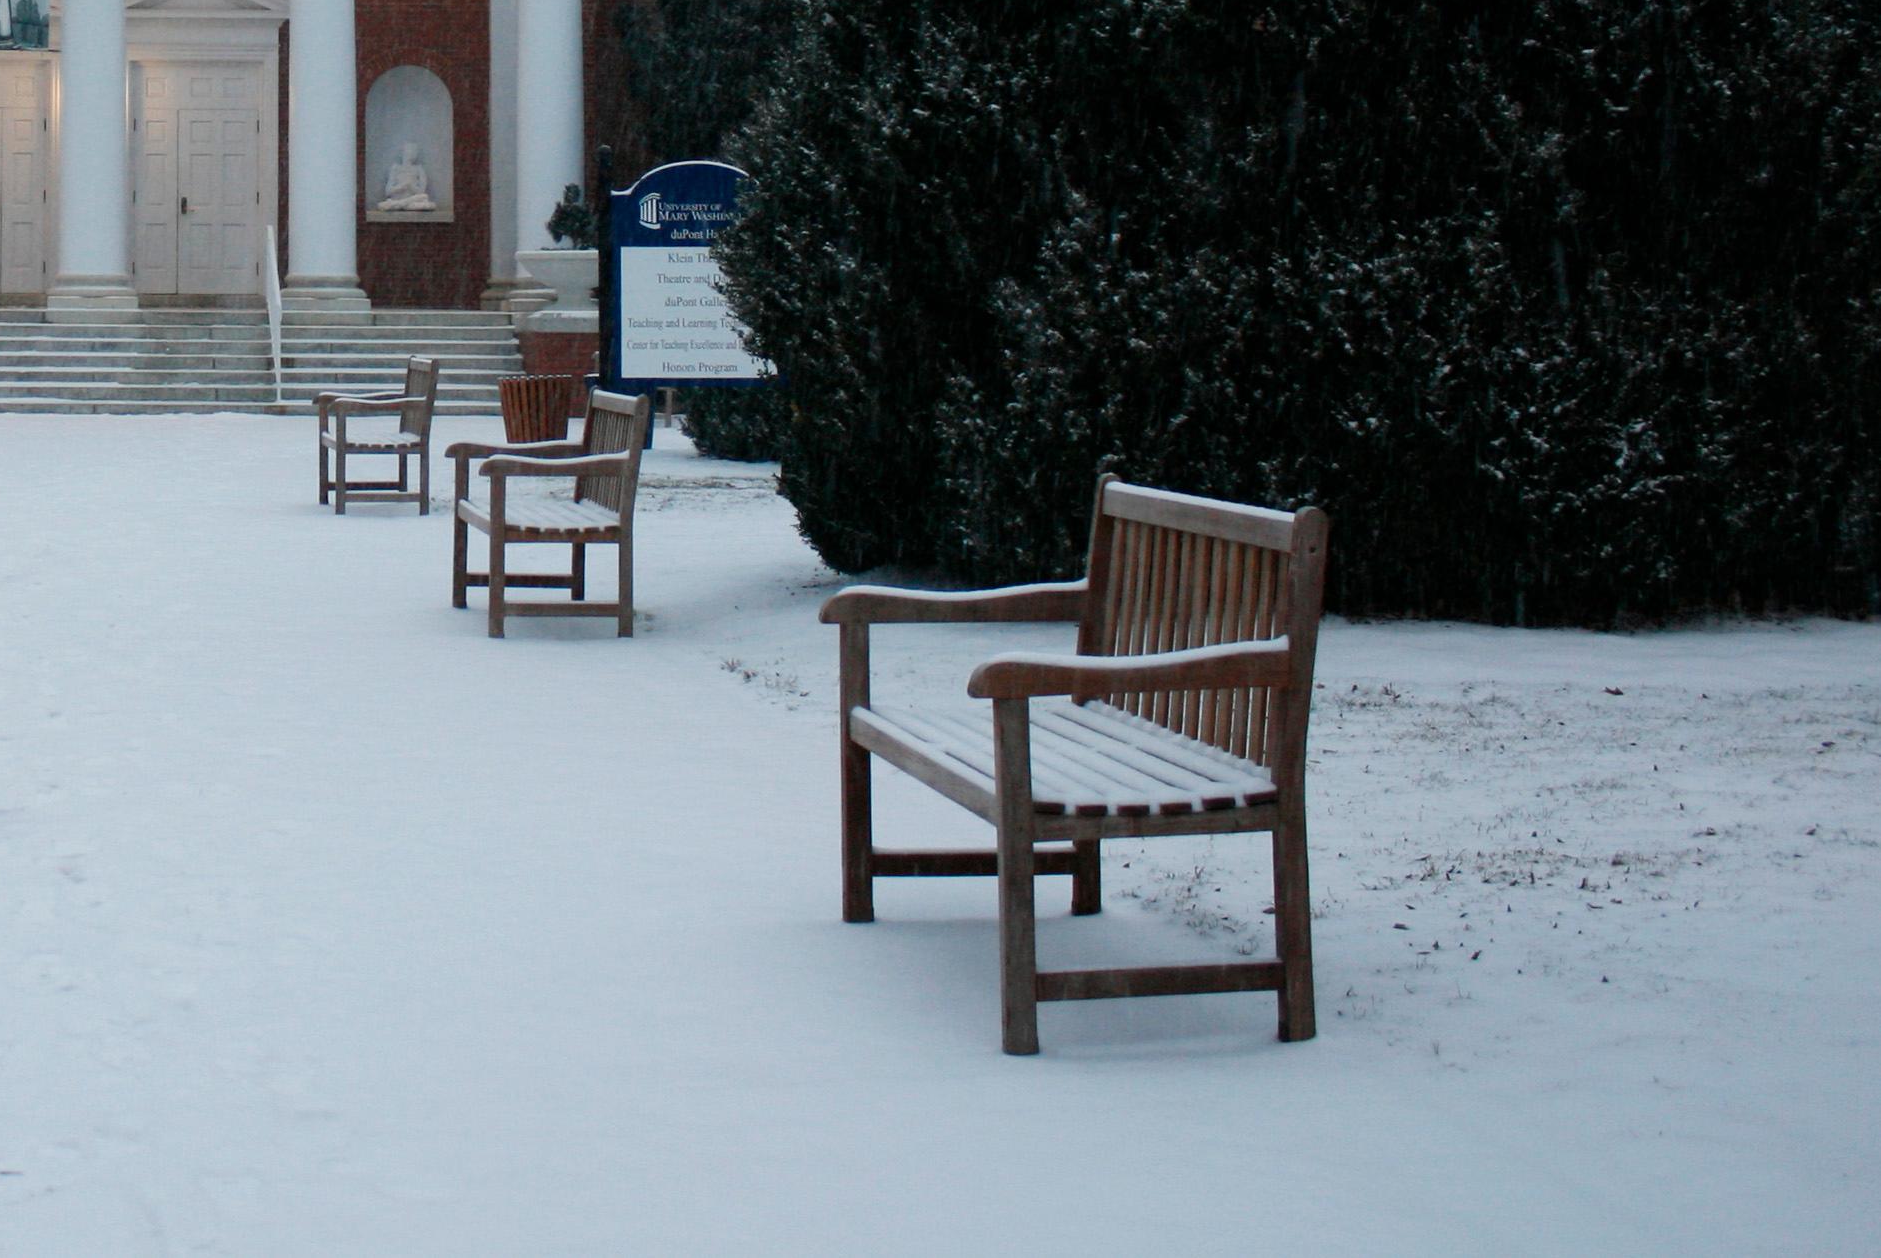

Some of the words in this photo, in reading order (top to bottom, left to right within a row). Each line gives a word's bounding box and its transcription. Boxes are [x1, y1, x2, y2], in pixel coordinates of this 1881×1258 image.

[658, 202, 708, 212] UNIVERSITY
[710, 202, 722, 211] OF
[658, 210, 689, 222] MARY
[670, 228, 704, 240] duPont
[668, 253, 694, 263] Klein
[657, 273, 692, 284] Theatre
[694, 273, 710, 284] and
[664, 296, 697, 307] duPont
[627, 317, 664, 330] Teaching
[665, 317, 680, 328] and
[682, 317, 718, 330] Learning
[660, 340, 689, 352] Teaching
[662, 362, 696, 373] Honors
[699, 362, 738, 374] Program
